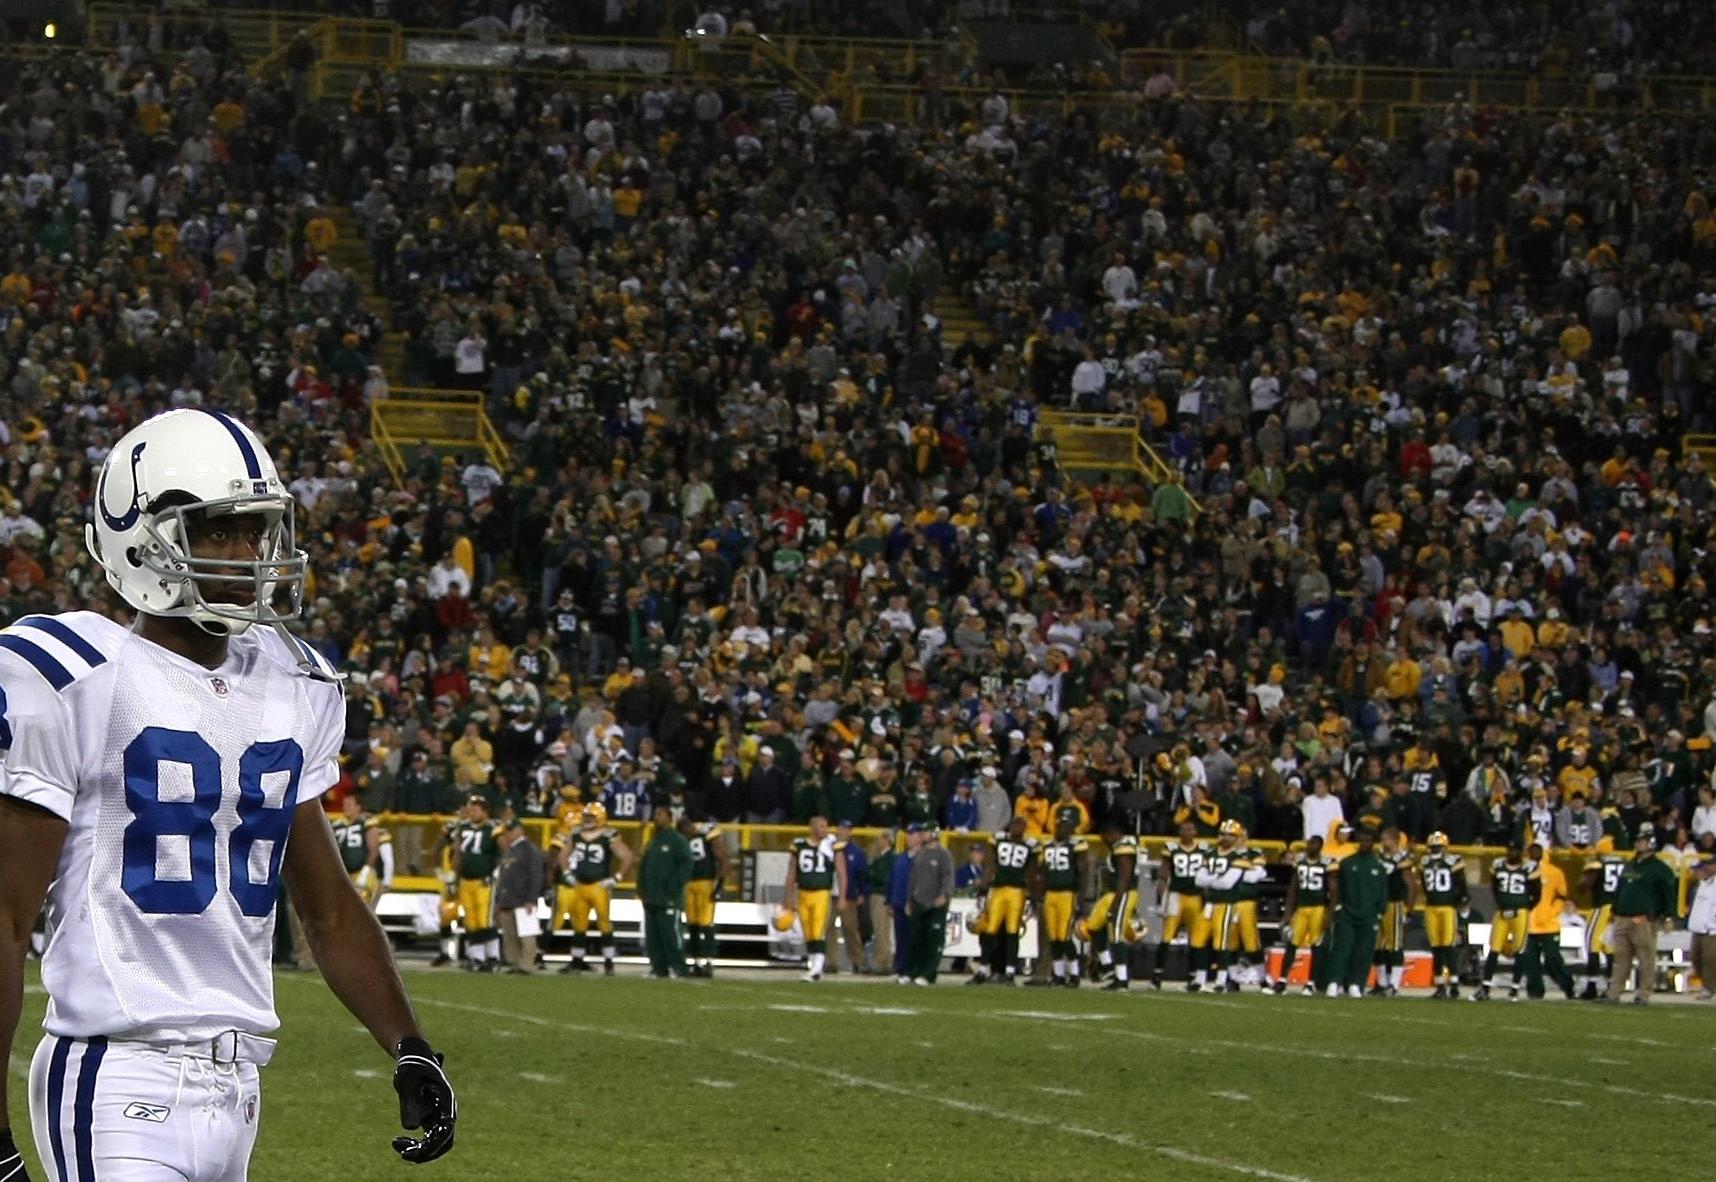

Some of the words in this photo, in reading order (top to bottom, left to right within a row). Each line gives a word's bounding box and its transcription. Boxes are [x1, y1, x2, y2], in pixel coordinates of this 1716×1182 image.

[1411, 772, 1432, 793] 15
[615, 793, 636, 816] 18
[122, 727, 305, 917] 88
[335, 824, 363, 848] 75
[461, 829, 484, 854] 71
[799, 849, 825, 873] 61
[998, 842, 1029, 867] 88
[1173, 853, 1204, 877] 82
[1496, 871, 1526, 895] 36
